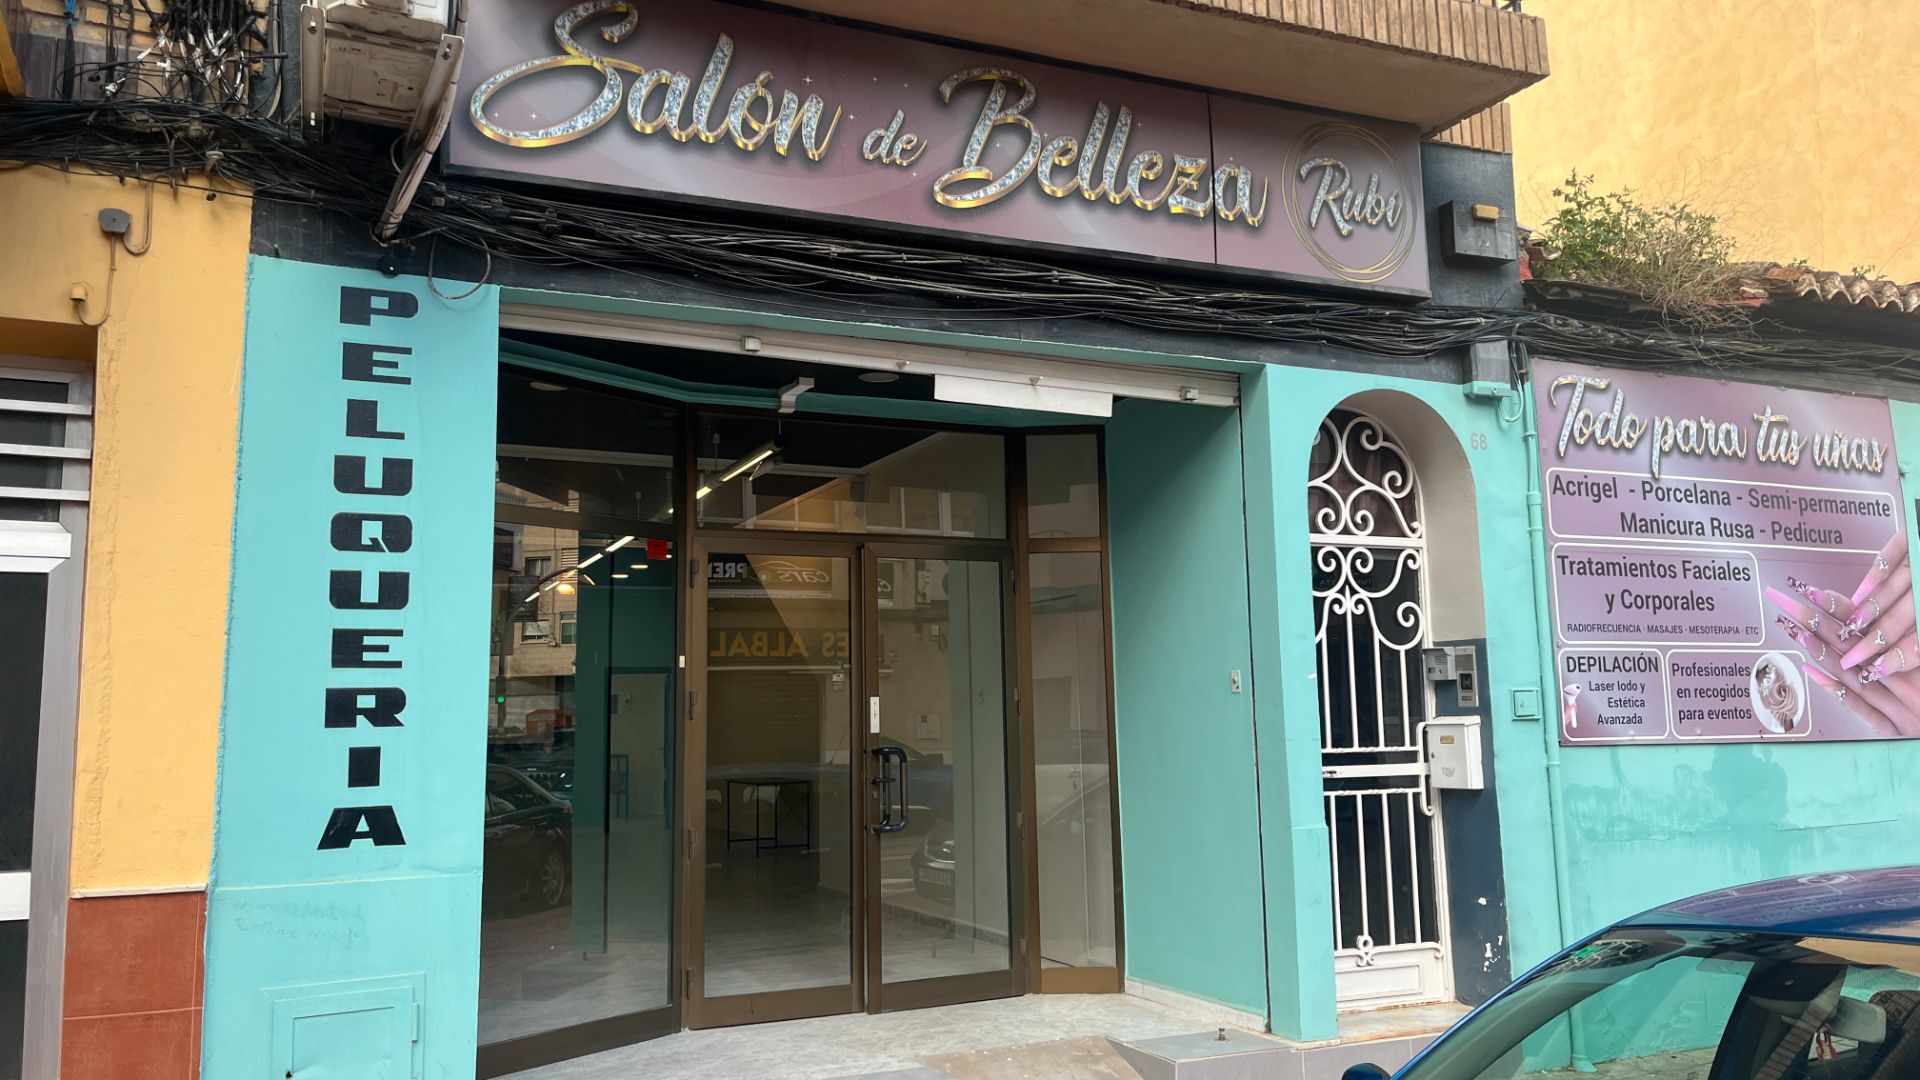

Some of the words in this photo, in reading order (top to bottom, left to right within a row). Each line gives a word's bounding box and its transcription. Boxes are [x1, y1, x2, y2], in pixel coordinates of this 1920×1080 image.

[469, 0, 842, 161] Salón
[862, 109, 928, 167] de
[933, 66, 1269, 228] Belleza
[1550, 374, 1648, 457] Todo
[1651, 415, 1747, 479] para
[1752, 405, 1807, 466] tus
[1812, 430, 1887, 473] uñas
[1471, 432, 1488, 450] 68
[1552, 474, 1618, 503] Acrigel
[1641, 480, 1731, 506] Porcelana
[1748, 488, 1891, 517] Semi-permanente
[1620, 511, 1705, 537] Manicura
[1710, 517, 1755, 539] Rusa
[1770, 521, 1843, 545] Pedicura
[317, 286, 419, 850] PELUQUERIA
[1557, 555, 1677, 579] Tratamientos
[1682, 559, 1751, 582] Faciales
[1605, 593, 1615, 614] y
[1620, 588, 1715, 615] Corporales
[1567, 623, 1641, 633] RADIOFRECUENCIA
[1647, 625, 1683, 634] MASAJES
[1689, 626, 1740, 635] MESOTERAPIA
[1745, 627, 1759, 635] ETC
[1566, 653, 1659, 673] DEPILACIÓN
[1672, 662, 1751, 677] Profesionales
[1588, 681, 1615, 692] Laser
[1640, 684, 1646, 694] y
[1676, 688, 1690, 698] en
[1694, 684, 1750, 701] recogidos
[1607, 697, 1645, 708] Estética
[1597, 714, 1643, 725] Avanzada
[1678, 711, 1705, 723] para
[1708, 708, 1752, 720] eventos
